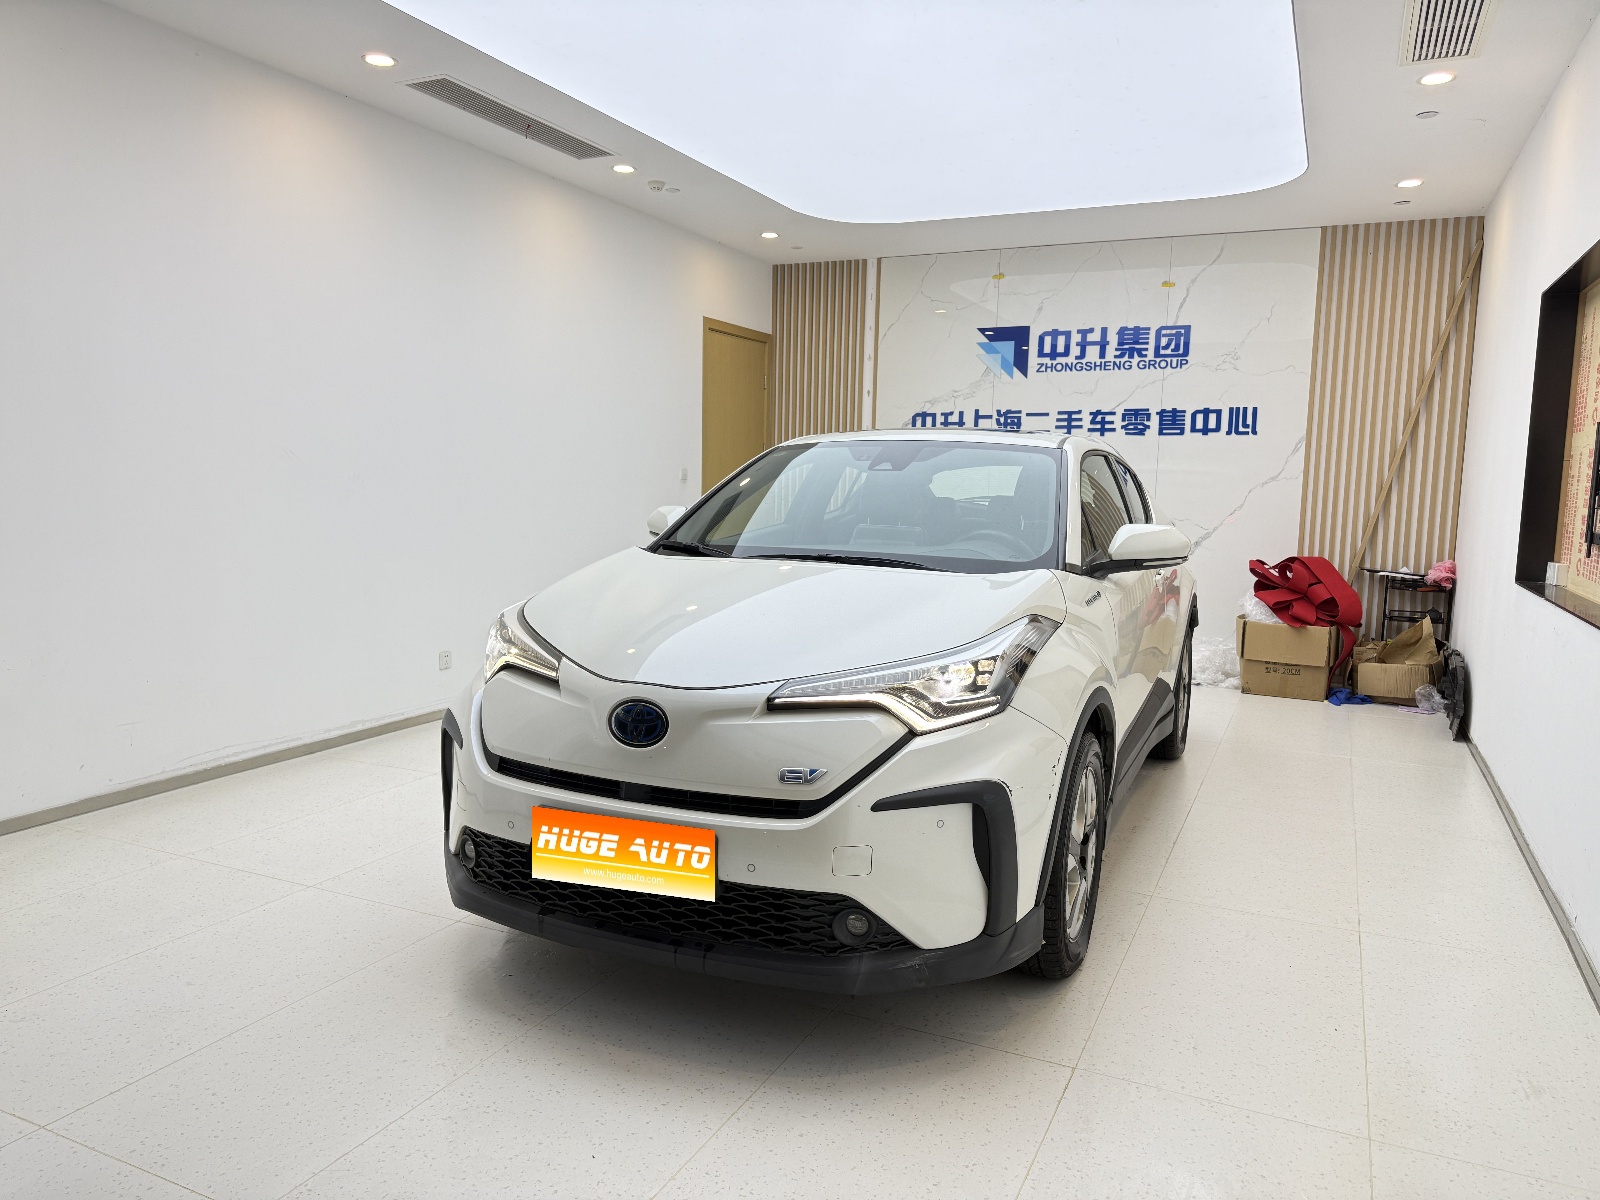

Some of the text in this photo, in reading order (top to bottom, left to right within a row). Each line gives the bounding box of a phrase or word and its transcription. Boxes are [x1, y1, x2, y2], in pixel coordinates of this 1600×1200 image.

[1037, 325, 1192, 360] 中升集团
[1036, 358, 1189, 373] ZHONGSHENG GROUP
[778, 767, 828, 785] EV
